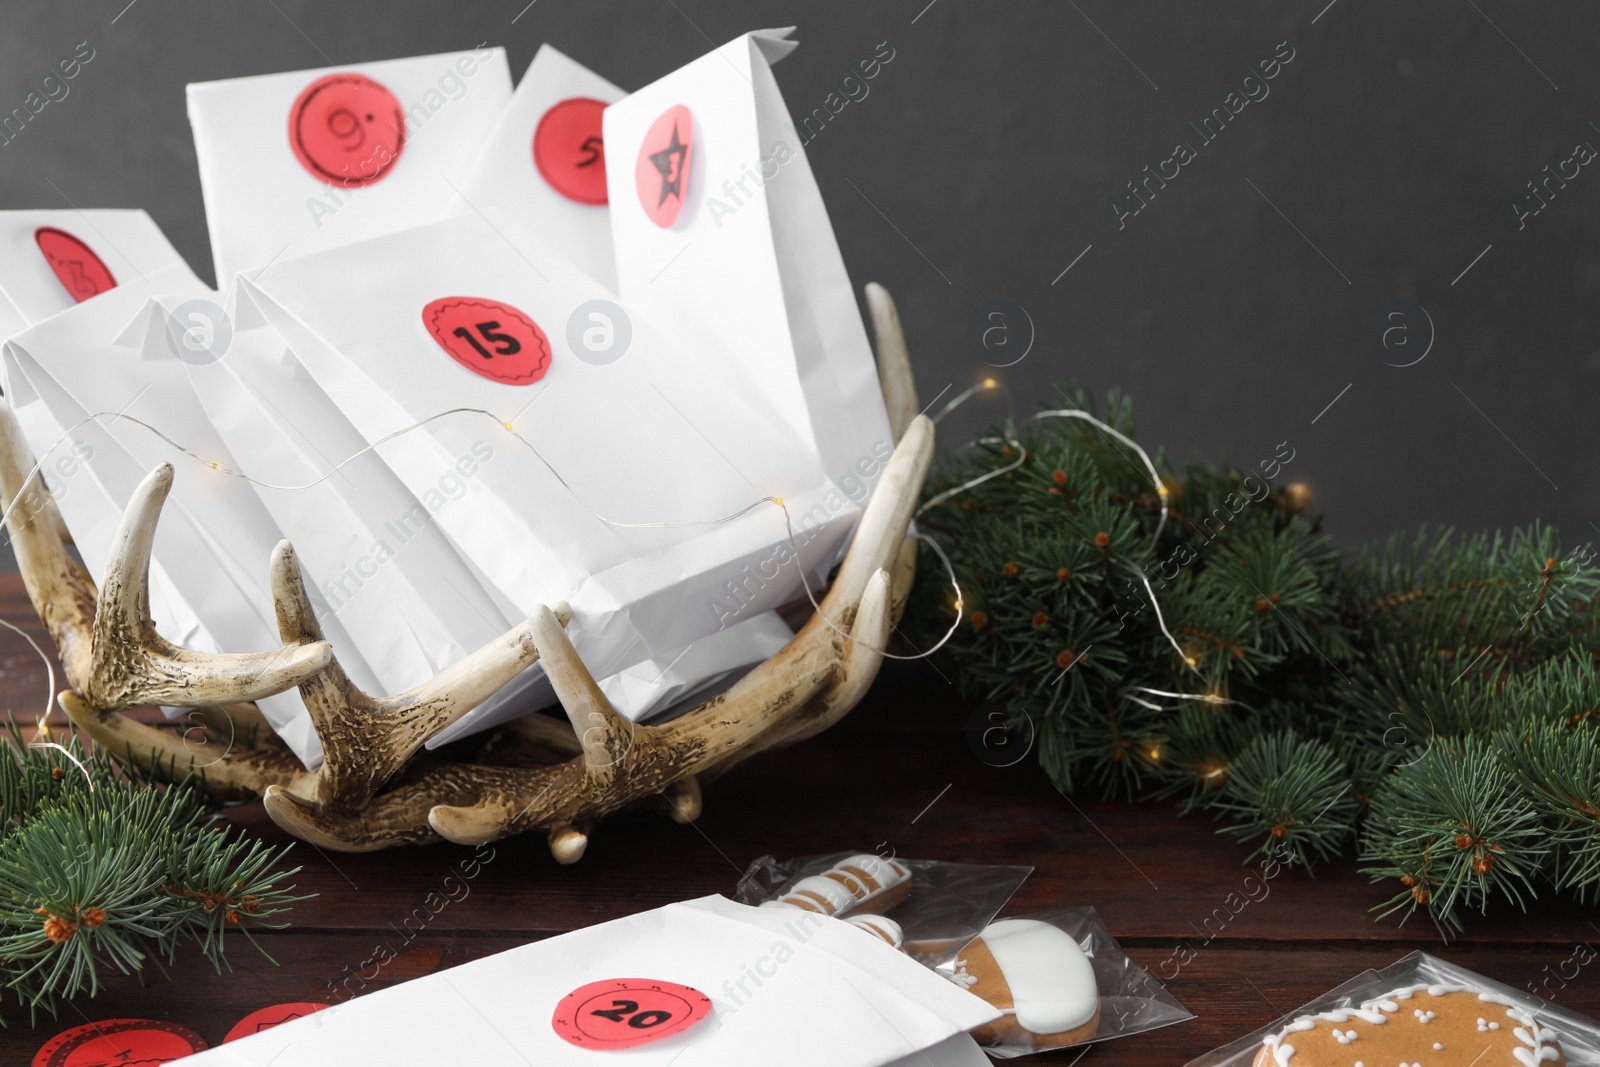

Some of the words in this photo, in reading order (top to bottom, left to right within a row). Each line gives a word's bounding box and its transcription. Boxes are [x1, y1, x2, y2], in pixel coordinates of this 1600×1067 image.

[576, 135, 604, 169] 5
[453, 320, 521, 360] 15
[590, 1000, 672, 1029] 20
